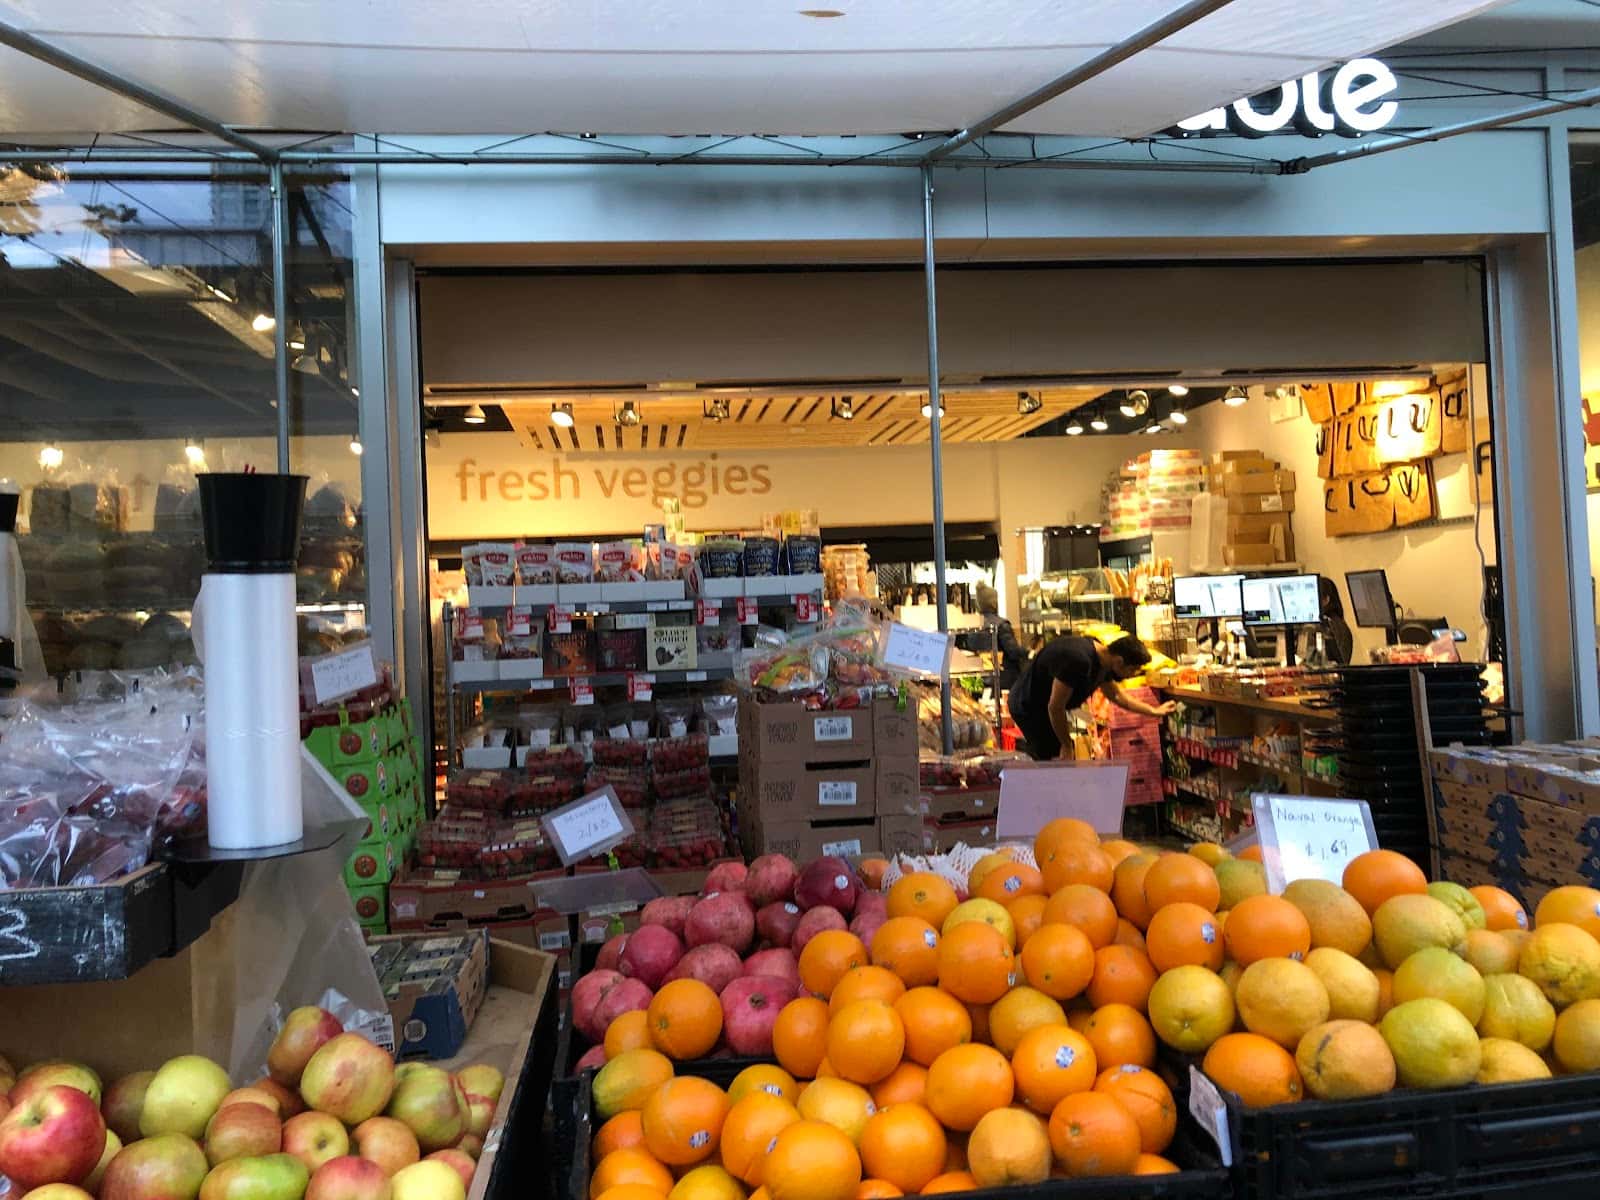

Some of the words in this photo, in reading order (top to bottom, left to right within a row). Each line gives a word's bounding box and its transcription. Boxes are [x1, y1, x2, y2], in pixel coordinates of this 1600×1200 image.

[1177, 58, 1399, 131] ole
[455, 457, 580, 502] fresh
[594, 453, 772, 508] veggies
